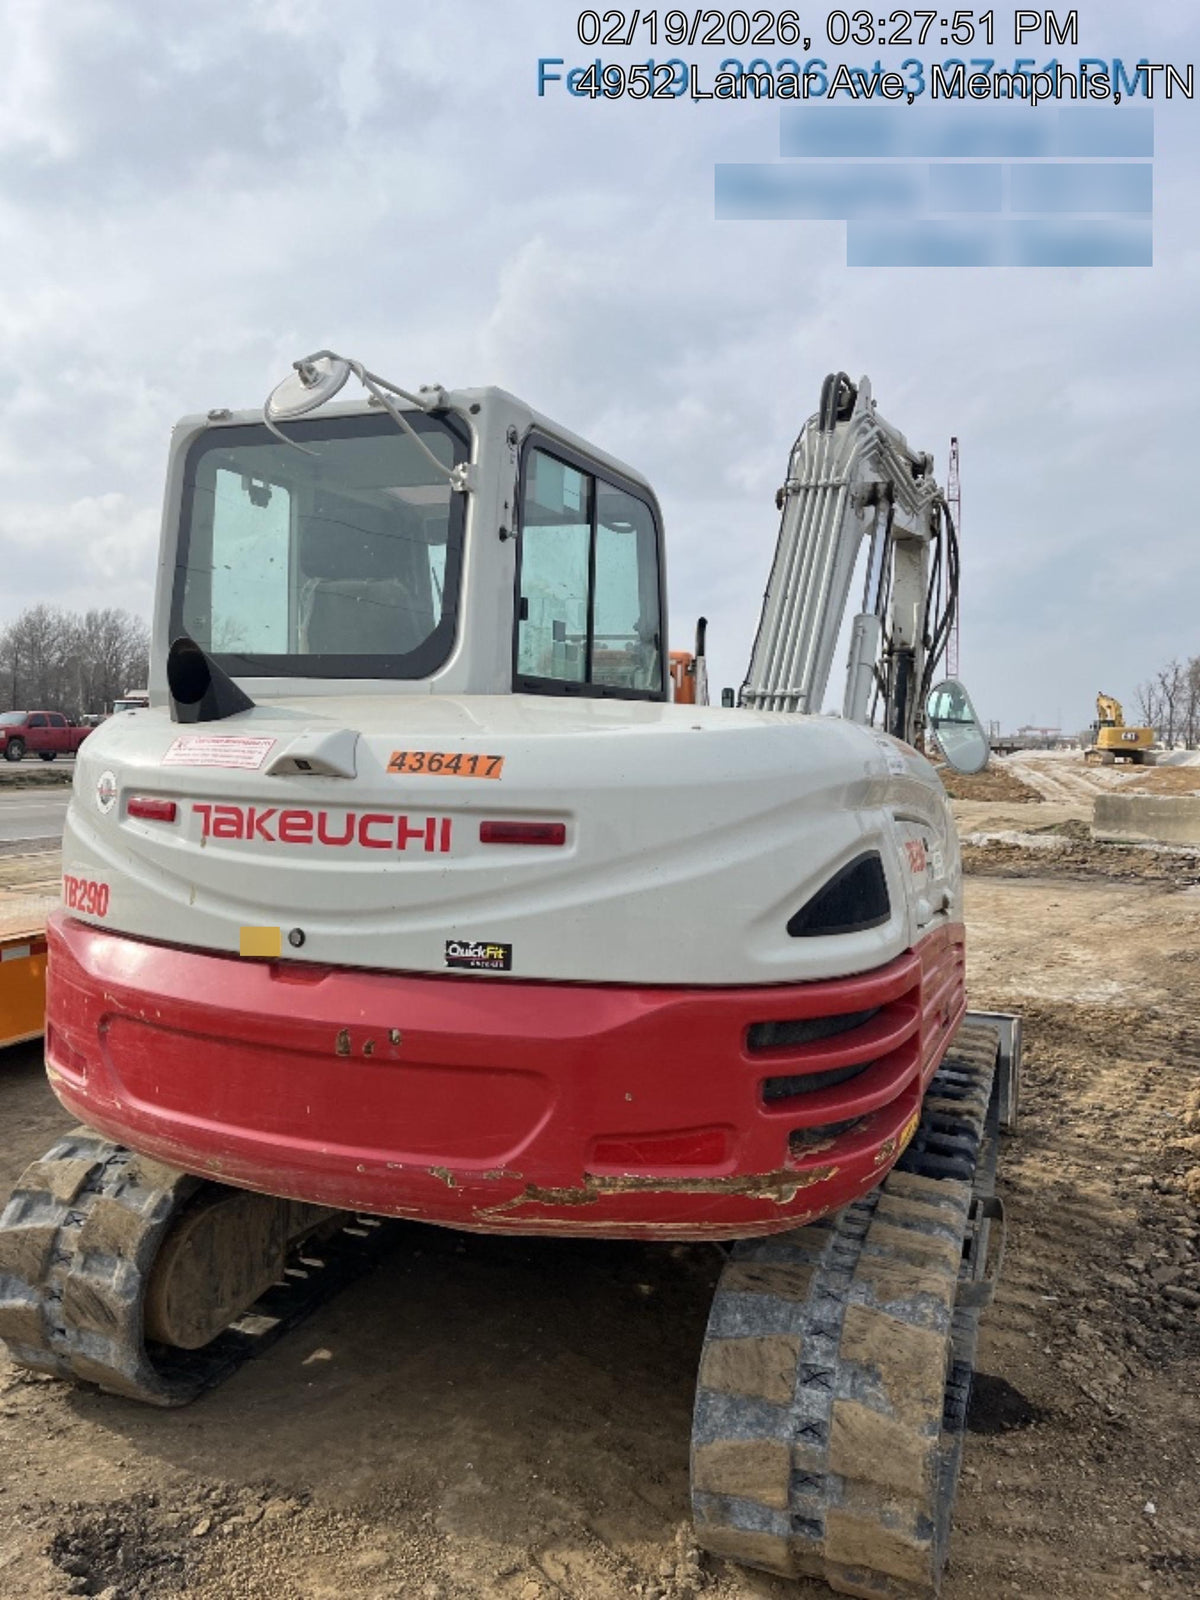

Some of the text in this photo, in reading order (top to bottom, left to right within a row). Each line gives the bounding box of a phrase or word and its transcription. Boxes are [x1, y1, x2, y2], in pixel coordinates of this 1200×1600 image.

[389, 751, 501, 776] 436417
[63, 873, 109, 918] TB290
[448, 943, 505, 959] QuickFit
